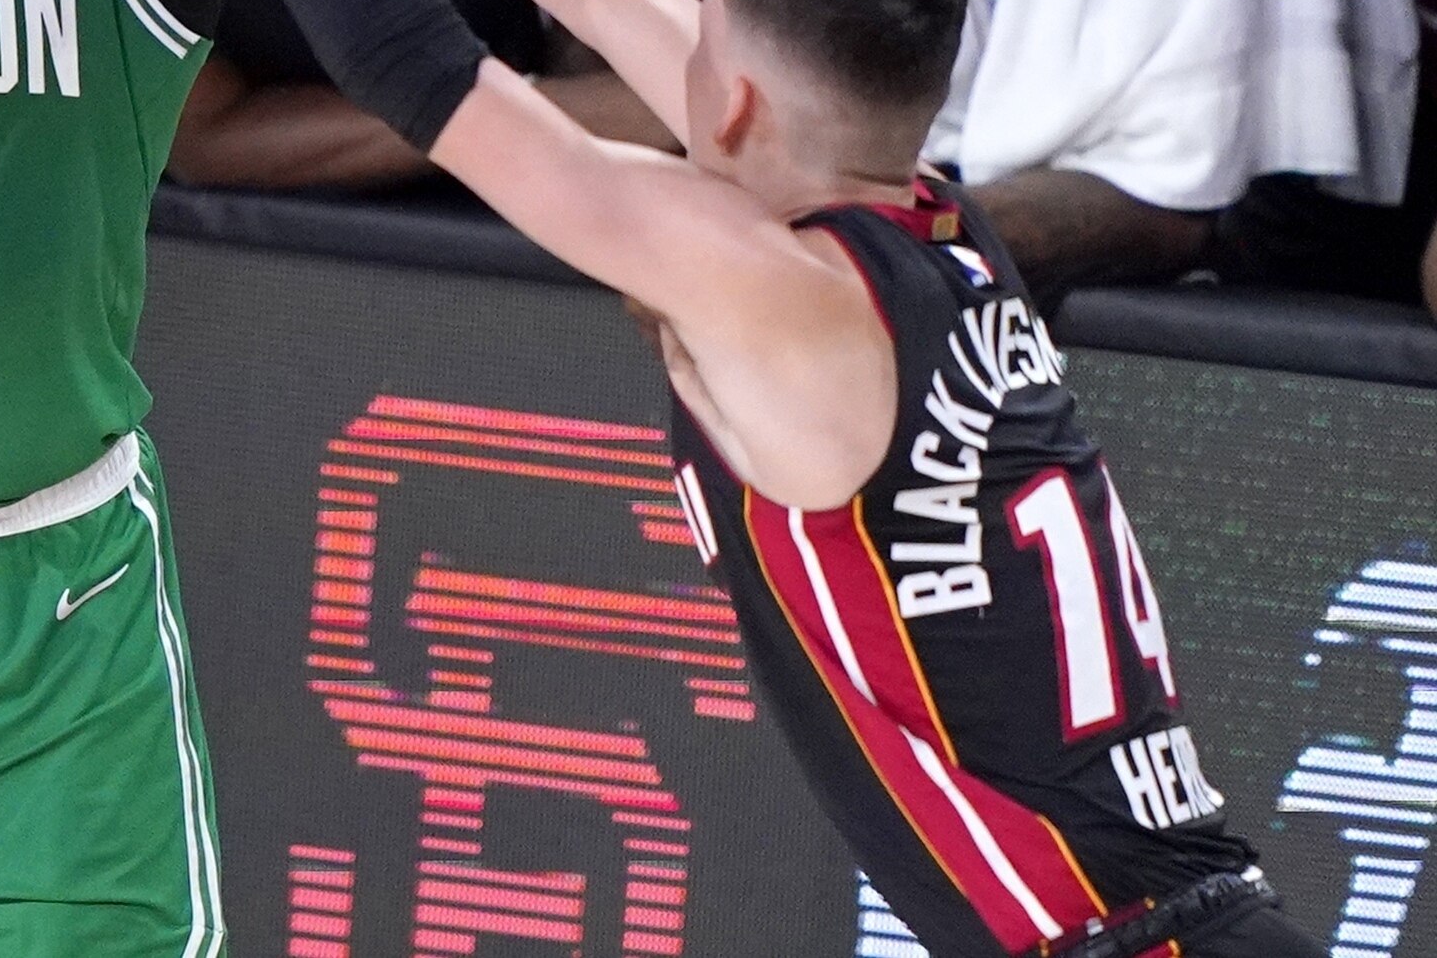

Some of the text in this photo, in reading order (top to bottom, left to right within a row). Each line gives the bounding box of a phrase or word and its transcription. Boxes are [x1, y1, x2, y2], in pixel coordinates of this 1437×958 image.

[891, 296, 1050, 618] BLACK LVES
[1004, 454, 1182, 741] 14
